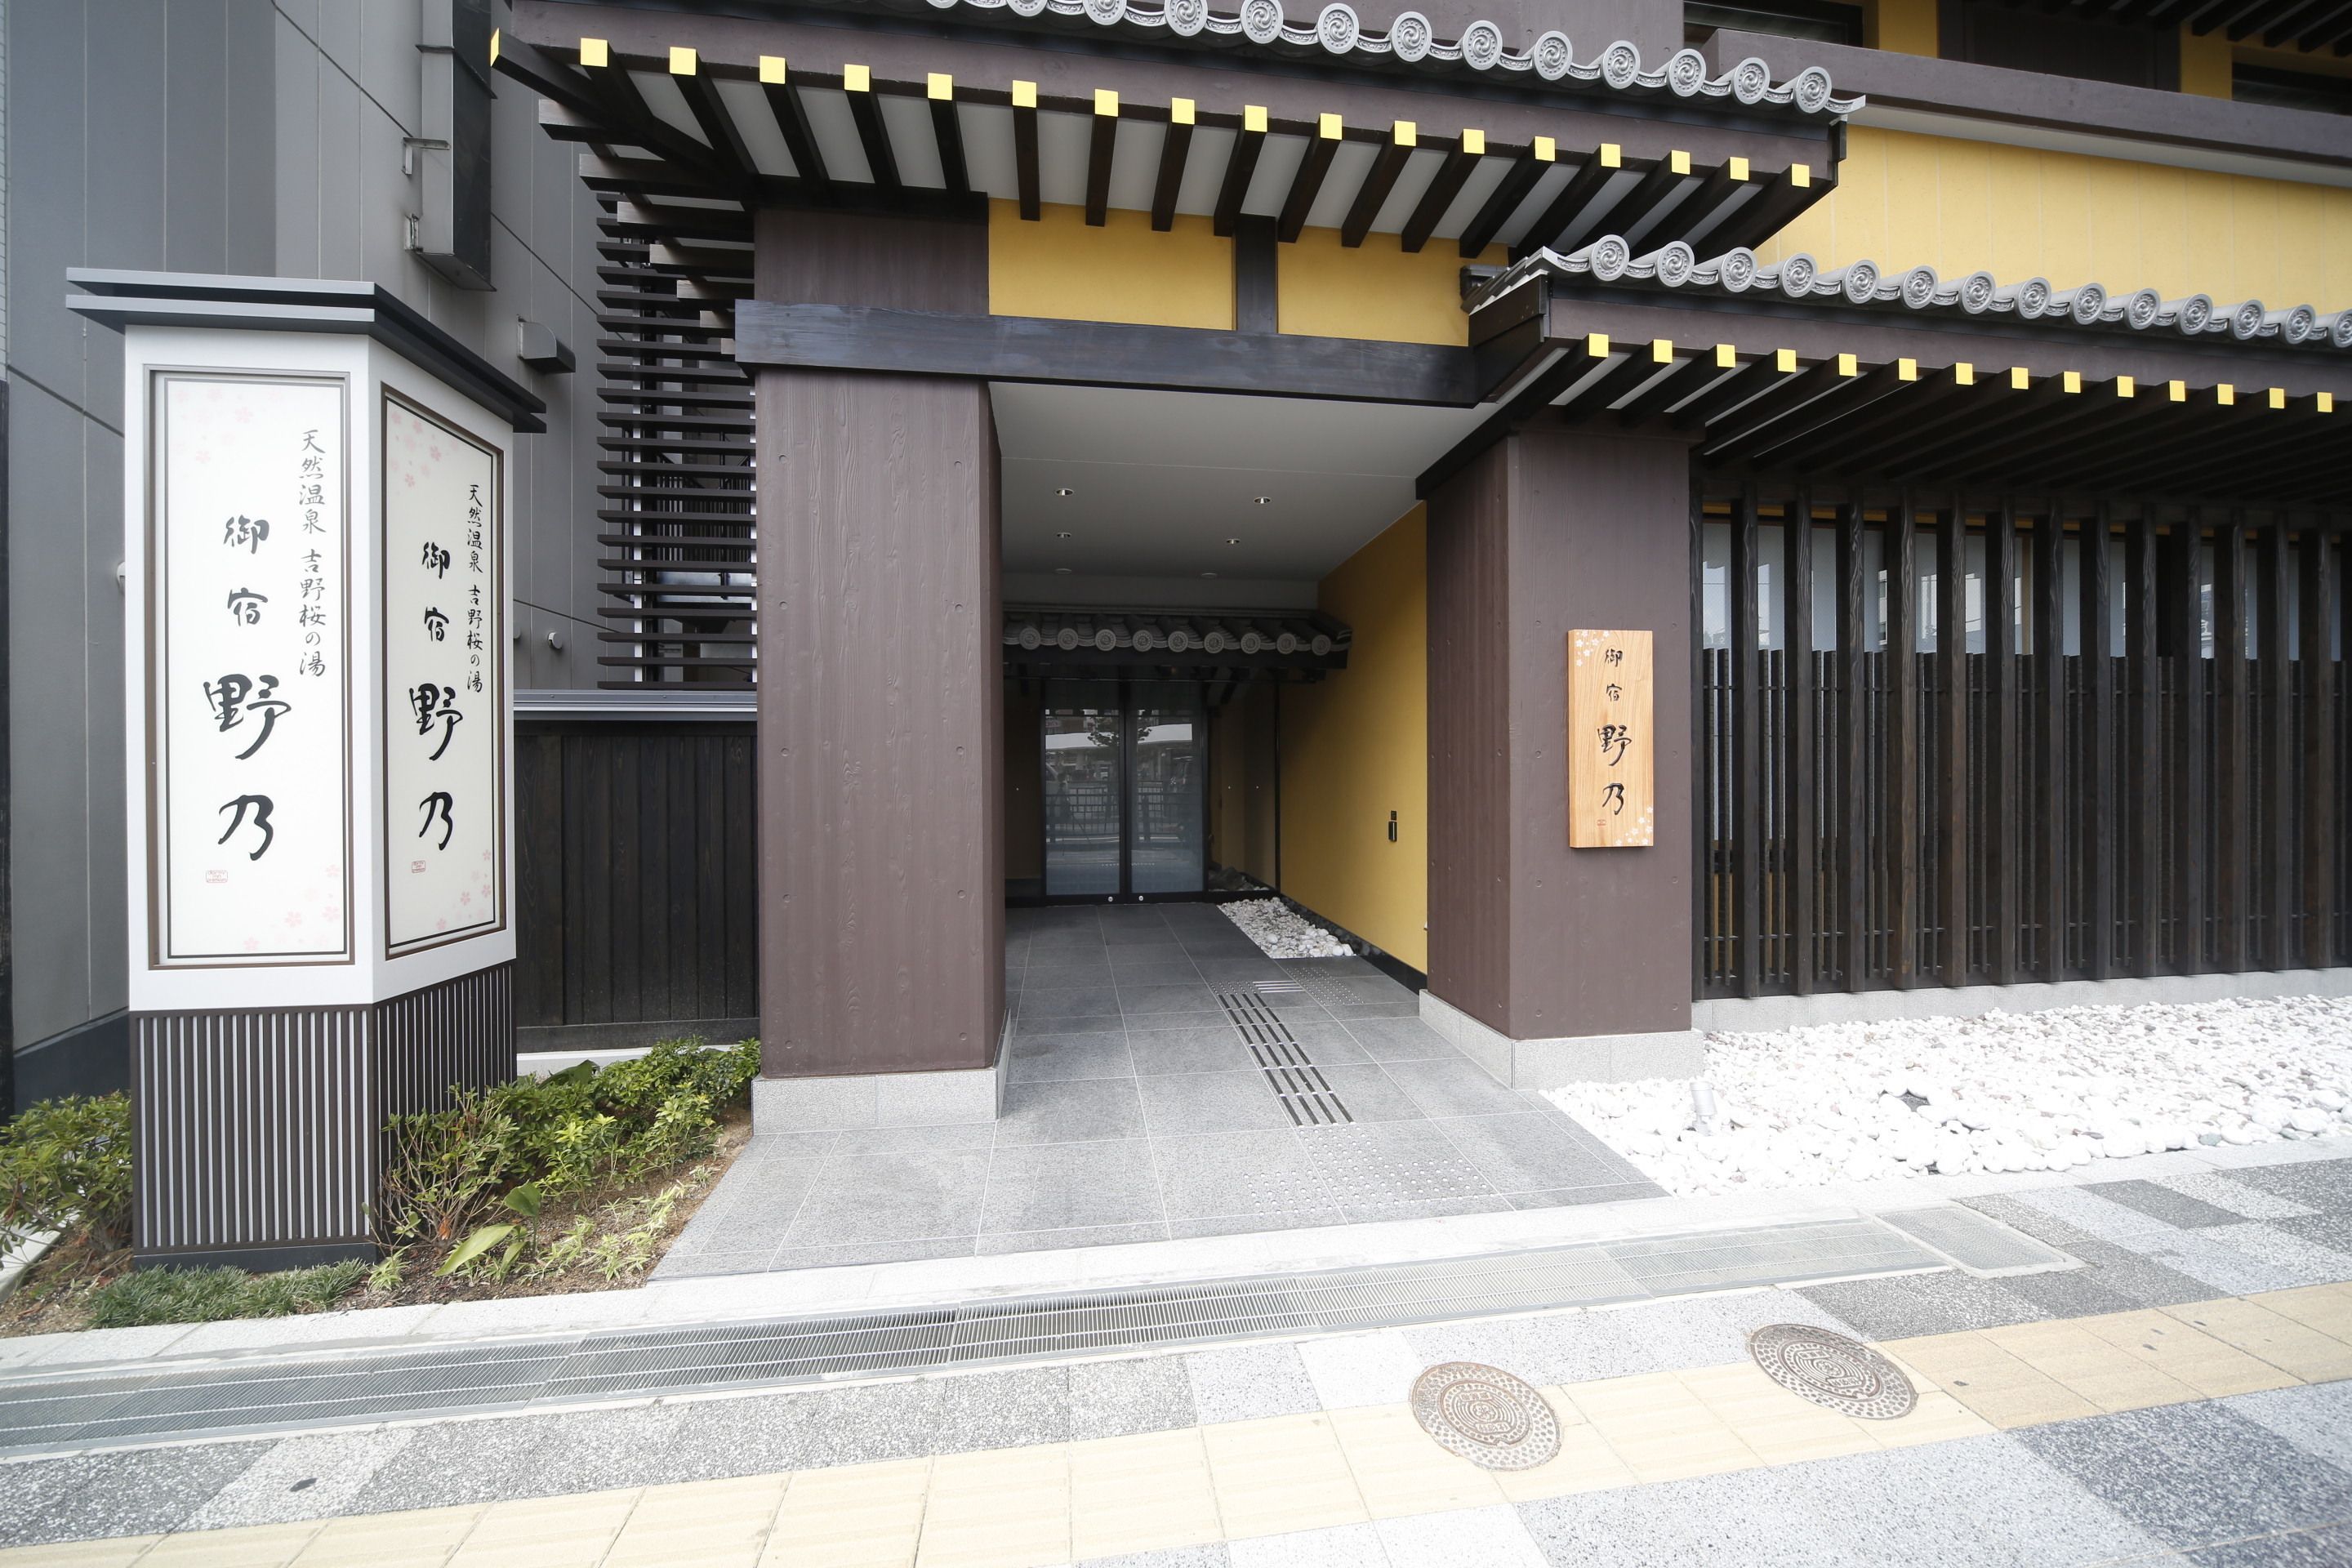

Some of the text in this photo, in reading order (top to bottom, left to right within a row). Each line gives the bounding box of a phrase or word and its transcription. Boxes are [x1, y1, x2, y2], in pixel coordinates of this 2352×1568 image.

[299, 430, 326, 677] 天然温泉 吉野桜の湯
[466, 484, 483, 693] 天然温泉 吉野桜の湯
